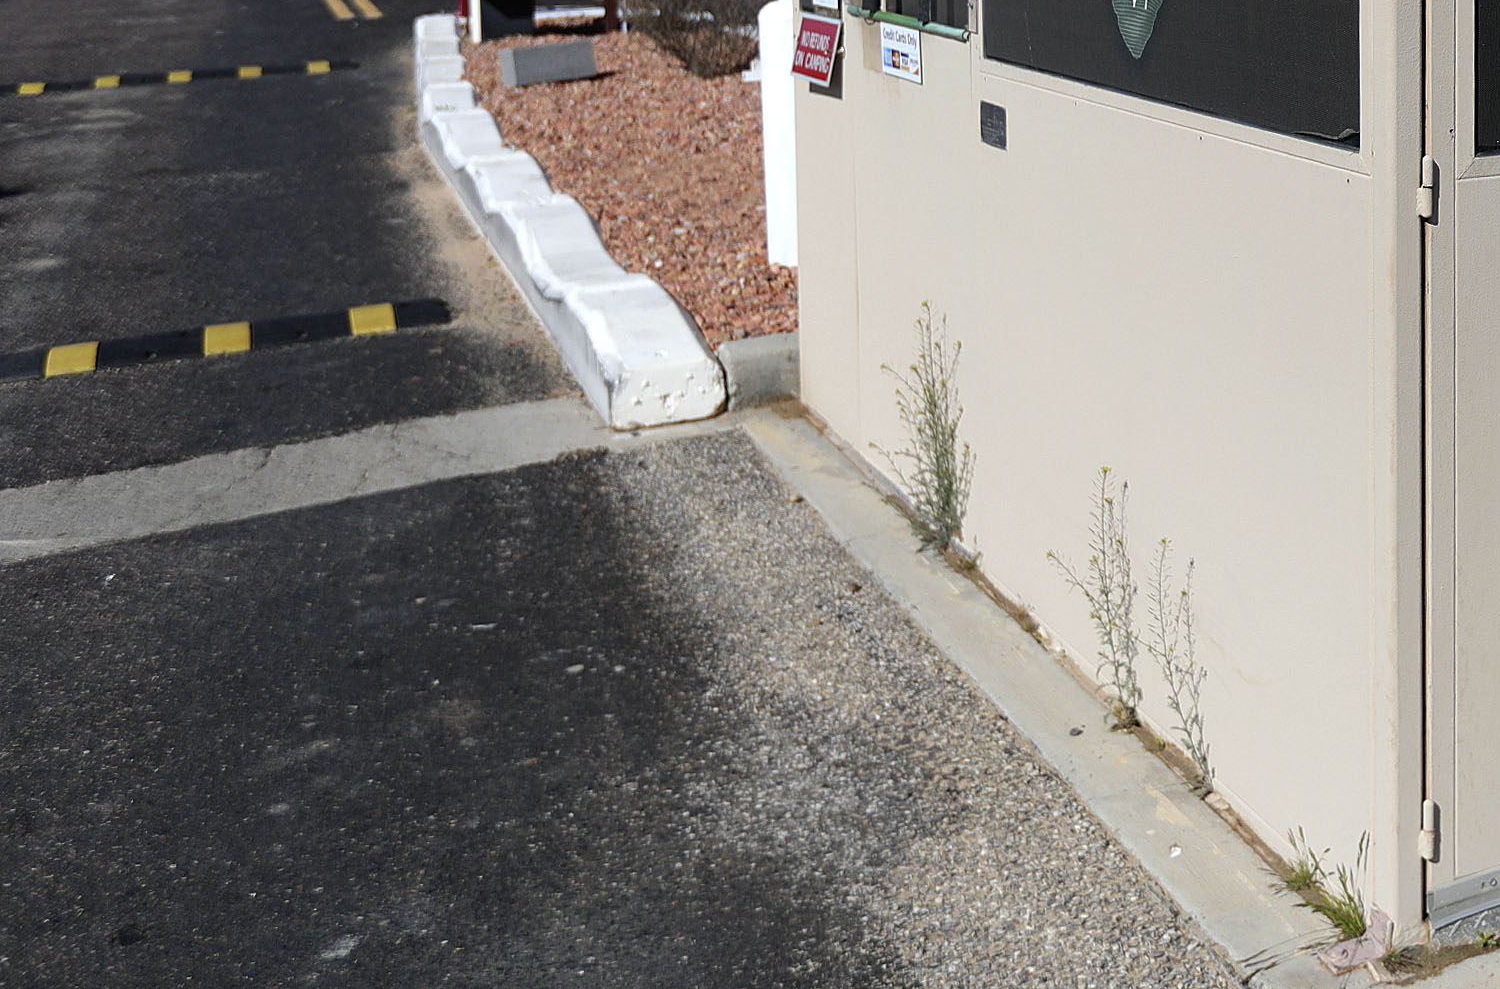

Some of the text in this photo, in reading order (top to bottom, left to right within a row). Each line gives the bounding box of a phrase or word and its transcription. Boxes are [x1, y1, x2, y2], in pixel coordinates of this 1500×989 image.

[801, 30, 831, 52] NO REFUNDS
[882, 27, 917, 51] Credit Cards Only
[795, 49, 831, 74] ON CAMPING
